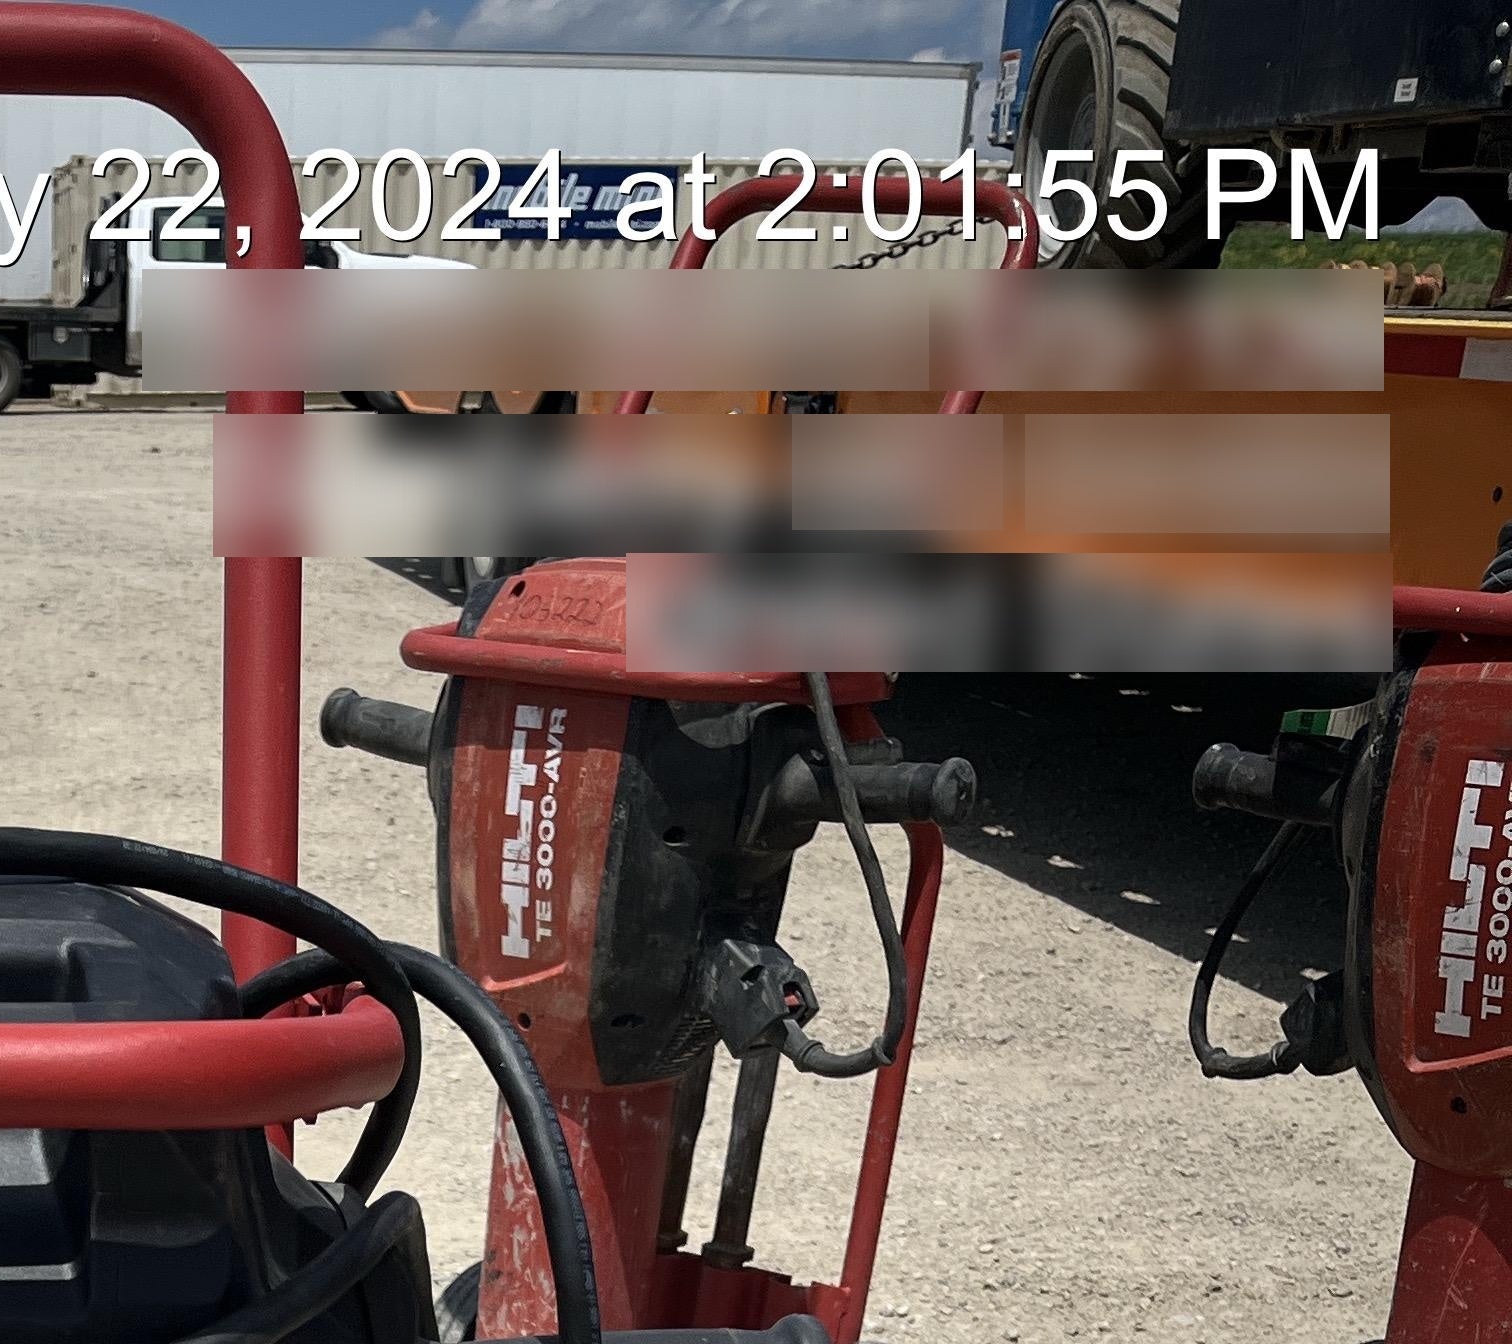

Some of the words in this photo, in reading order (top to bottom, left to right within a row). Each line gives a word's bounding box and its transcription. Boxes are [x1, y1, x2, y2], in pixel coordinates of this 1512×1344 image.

[500, 704, 544, 959] HILTI
[536, 706, 568, 891] 3000-AVR
[1485, 782, 1512, 964] 3000-A
[535, 898, 553, 943] TE
[1433, 759, 1505, 1038] HILTI
[1480, 973, 1504, 1020] TE
